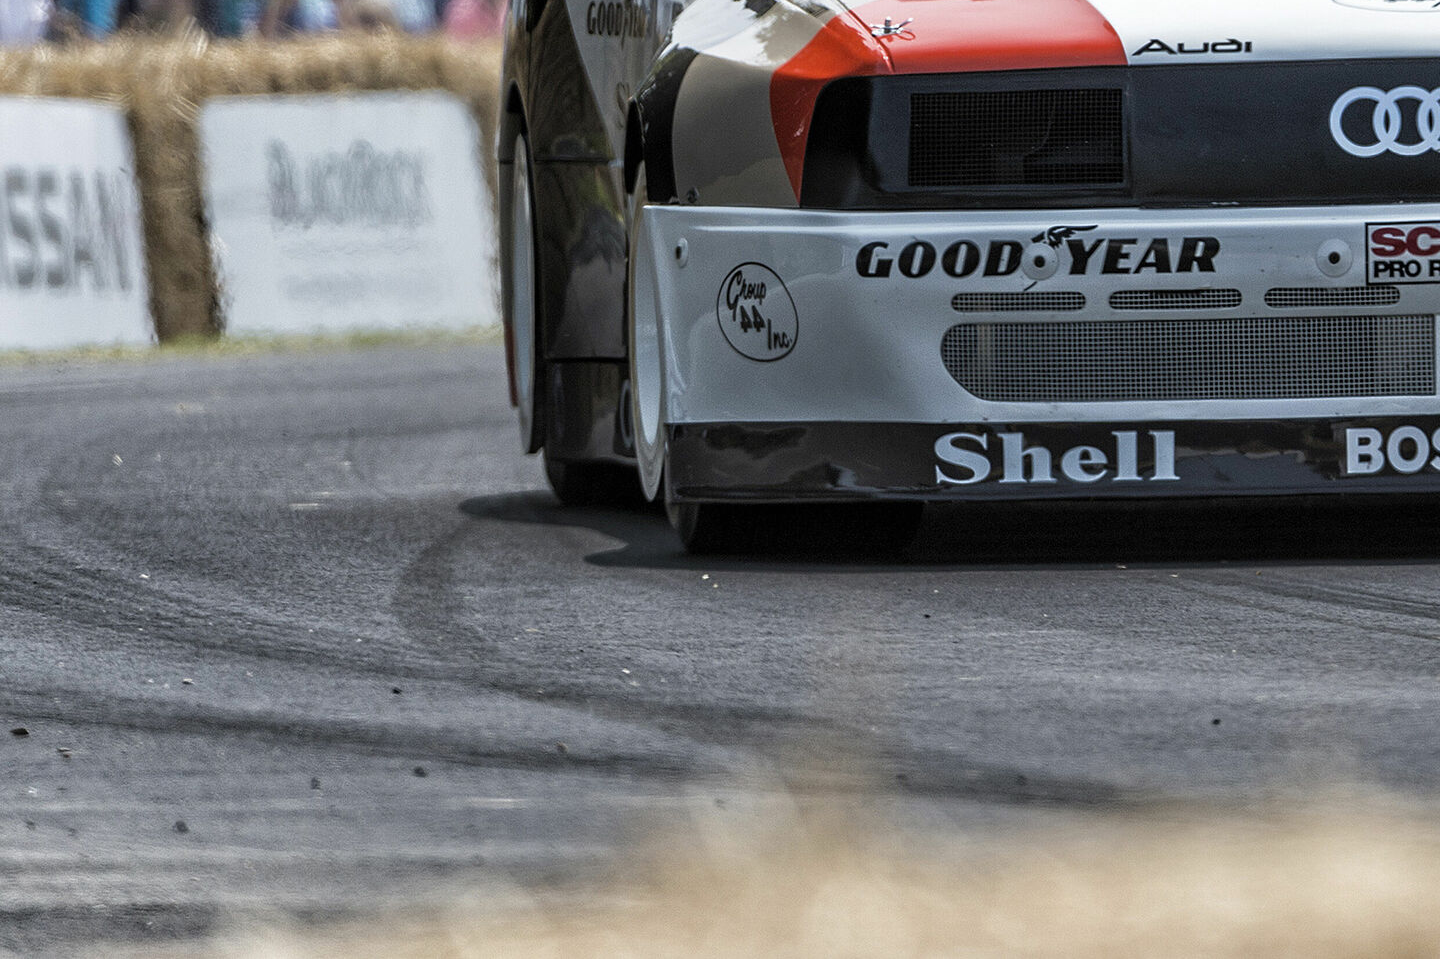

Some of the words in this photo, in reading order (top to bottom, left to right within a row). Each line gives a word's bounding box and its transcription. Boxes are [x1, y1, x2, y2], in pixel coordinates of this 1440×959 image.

[1131, 38, 1253, 57] Audi
[0, 167, 131, 291] SSAN
[1373, 259, 1422, 278] PRO
[726, 269, 767, 322] Group
[933, 429, 1181, 485] Shell
